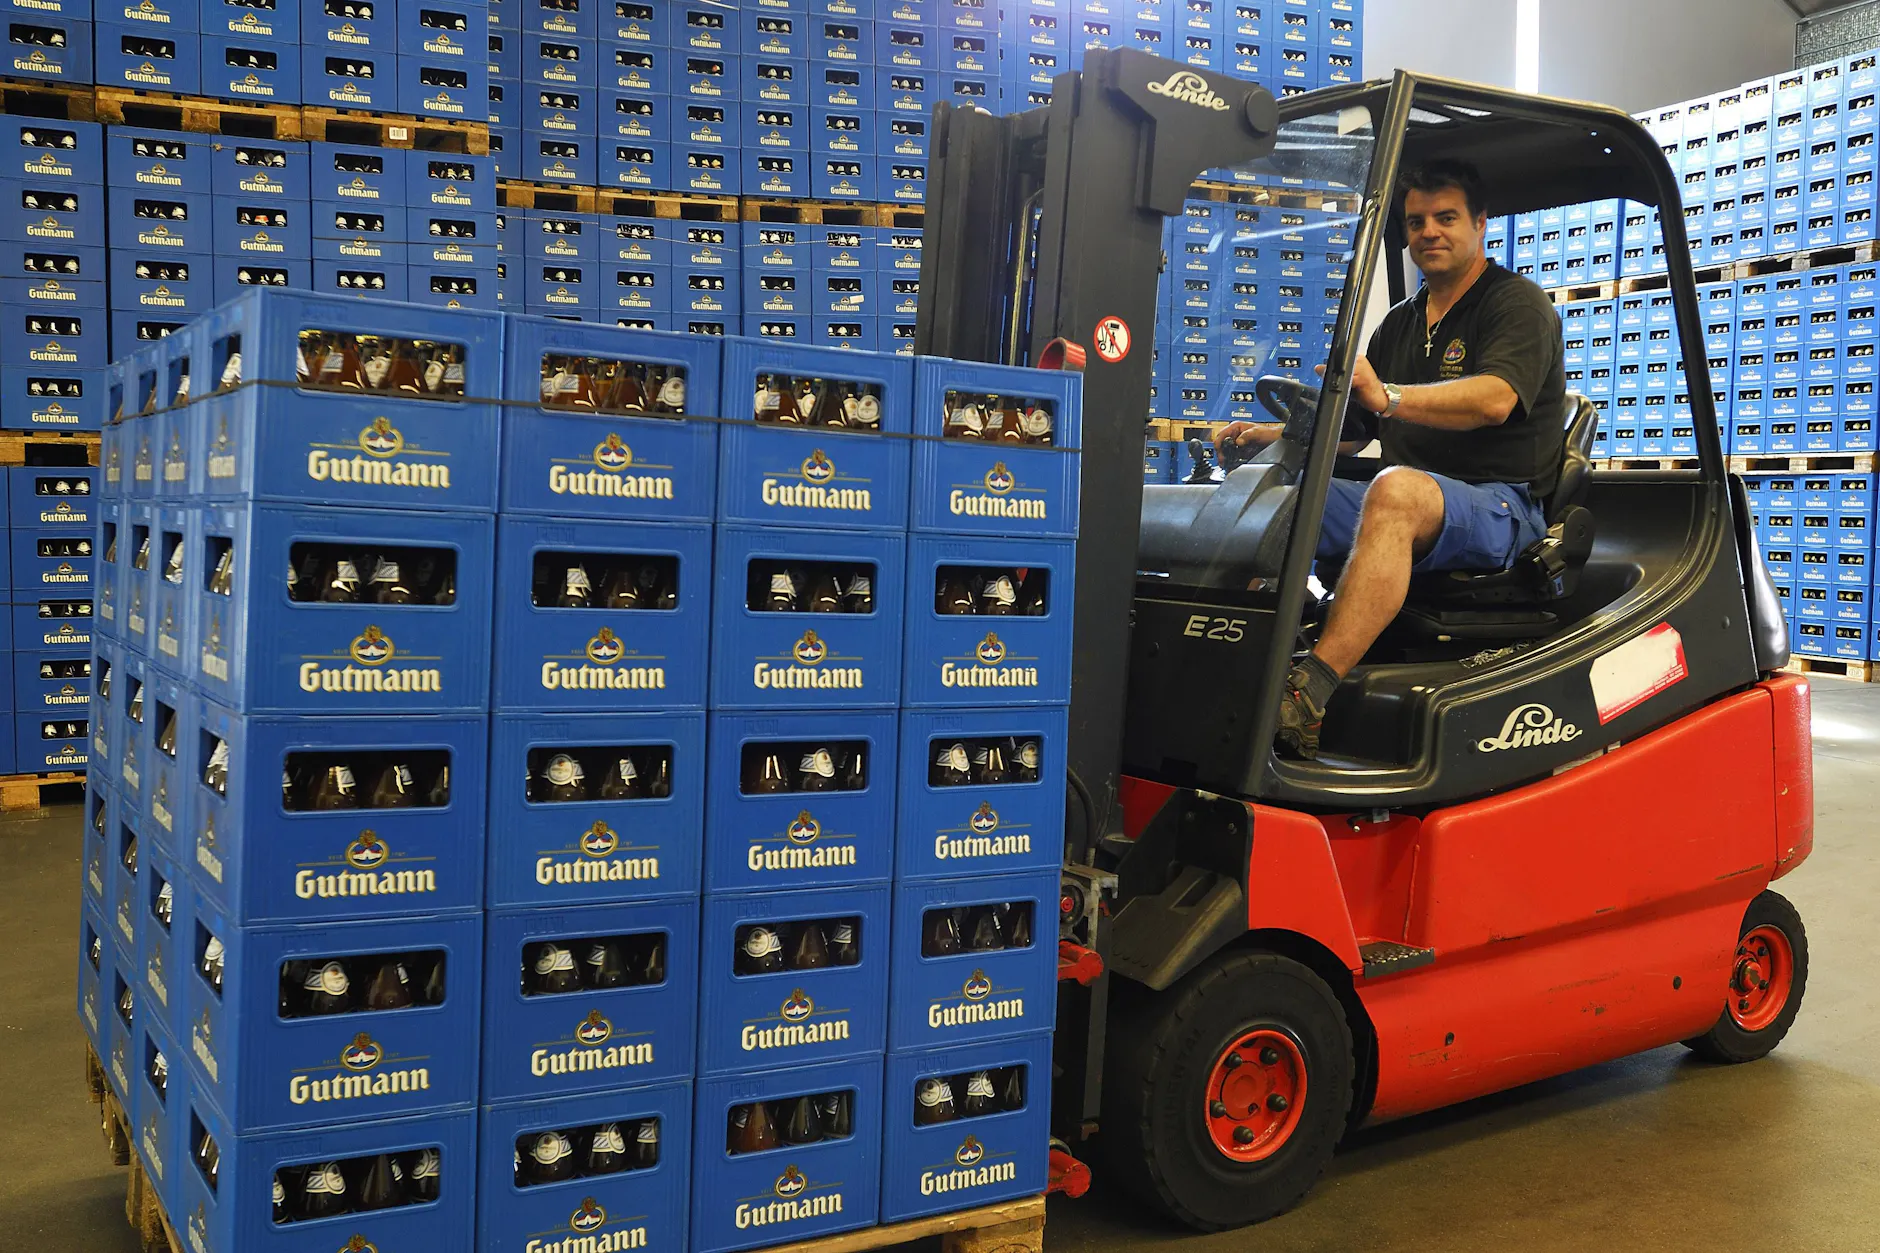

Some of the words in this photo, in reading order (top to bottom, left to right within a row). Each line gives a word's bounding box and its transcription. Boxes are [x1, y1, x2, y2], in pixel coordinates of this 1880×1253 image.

[827, 3, 856, 14] Gutmann
[124, 8, 170, 23] Gutmann
[892, 10, 921, 21] Gutmann
[543, 21, 577, 33] Gutmann
[955, 17, 983, 27] Gutmann
[228, 21, 272, 36] Gutmann
[327, 31, 370, 45] Gutmann
[618, 29, 650, 41] Gutmann
[423, 41, 464, 55] Gutmann
[690, 38, 721, 49] Gutmann
[760, 43, 790, 54] Gutmann
[827, 49, 857, 60] Gutmann
[893, 55, 921, 66] Gutmann
[14, 59, 62, 74] Gutmann
[956, 61, 984, 71] Gutmann
[125, 70, 171, 85] Gutmann
[543, 70, 577, 82] Gutmann
[230, 81, 274, 96] Gutmann
[618, 77, 650, 89] Gutmann
[690, 85, 721, 96] Gutmann
[760, 90, 790, 100] Gutmann
[1146, 70, 1230, 112] Linde
[329, 90, 371, 104] Gutmann
[828, 95, 858, 105] Gutmann
[423, 99, 464, 113] Gutmann
[894, 100, 922, 110] Gutmann
[543, 119, 576, 130] Gutmann
[618, 125, 651, 137] Gutmann
[691, 132, 722, 143] Gutmann
[760, 136, 790, 146] Gutmann
[829, 141, 858, 151] Gutmann
[894, 145, 923, 155] Gutmann
[24, 162, 72, 176] Gutmann
[543, 168, 576, 179] Gutmann
[136, 172, 182, 186] Gutmann
[619, 173, 651, 184] Gutmann
[690, 179, 721, 189] Gutmann
[240, 180, 283, 193] Gutmann
[337, 186, 379, 199] Gutmann
[761, 182, 791, 192] Gutmann
[830, 186, 859, 196] Gutmann
[431, 193, 471, 206] Gutmann
[894, 190, 923, 199] Gutmann
[27, 225, 74, 239] Gutmann
[138, 233, 184, 247] Gutmann
[240, 240, 284, 252] Gutmann
[339, 244, 381, 257] Gutmann
[433, 250, 473, 262] Gutmann
[545, 246, 578, 256] Gutmann
[619, 250, 651, 260] Gutmann
[691, 254, 722, 264] Gutmann
[763, 256, 793, 265] Gutmann
[830, 258, 860, 267] Gutmann
[29, 288, 76, 301] Gutmann
[140, 294, 185, 307] Gutmann
[546, 294, 579, 304] Gutmann
[619, 298, 651, 308] Gutmann
[691, 301, 722, 311] Gutmann
[763, 302, 793, 311] Gutmann
[830, 303, 860, 312] Gutmann
[30, 350, 77, 362] Gutmann
[32, 412, 79, 424] Gutmann
[308, 450, 450, 489] Gutmann
[549, 465, 674, 500] Gutmann
[762, 478, 871, 511] Gutmann
[950, 489, 1047, 519] Gutmann
[40, 512, 87, 522] Gutmann
[42, 573, 89, 583] Gutmann
[44, 634, 90, 644] Gutmann
[299, 662, 441, 693] Gutmann
[541, 661, 665, 690] Gutmann
[754, 662, 863, 689] Gutmann
[941, 662, 1038, 688] Gutmann
[45, 695, 90, 705] Gutmann
[1477, 703, 1583, 753] Linde
[935, 834, 1031, 860] Gutmann
[748, 845, 856, 871] Gutmann
[536, 857, 659, 885] Gutmann
[295, 869, 436, 899] Gutmann
[928, 998, 1024, 1028] Gutmann
[741, 1020, 849, 1051] Gutmann
[531, 1043, 654, 1077] Gutmann
[290, 1068, 430, 1104] Gutmann
[920, 1161, 1016, 1196] Gutmann
[735, 1193, 842, 1229] Gutmann
